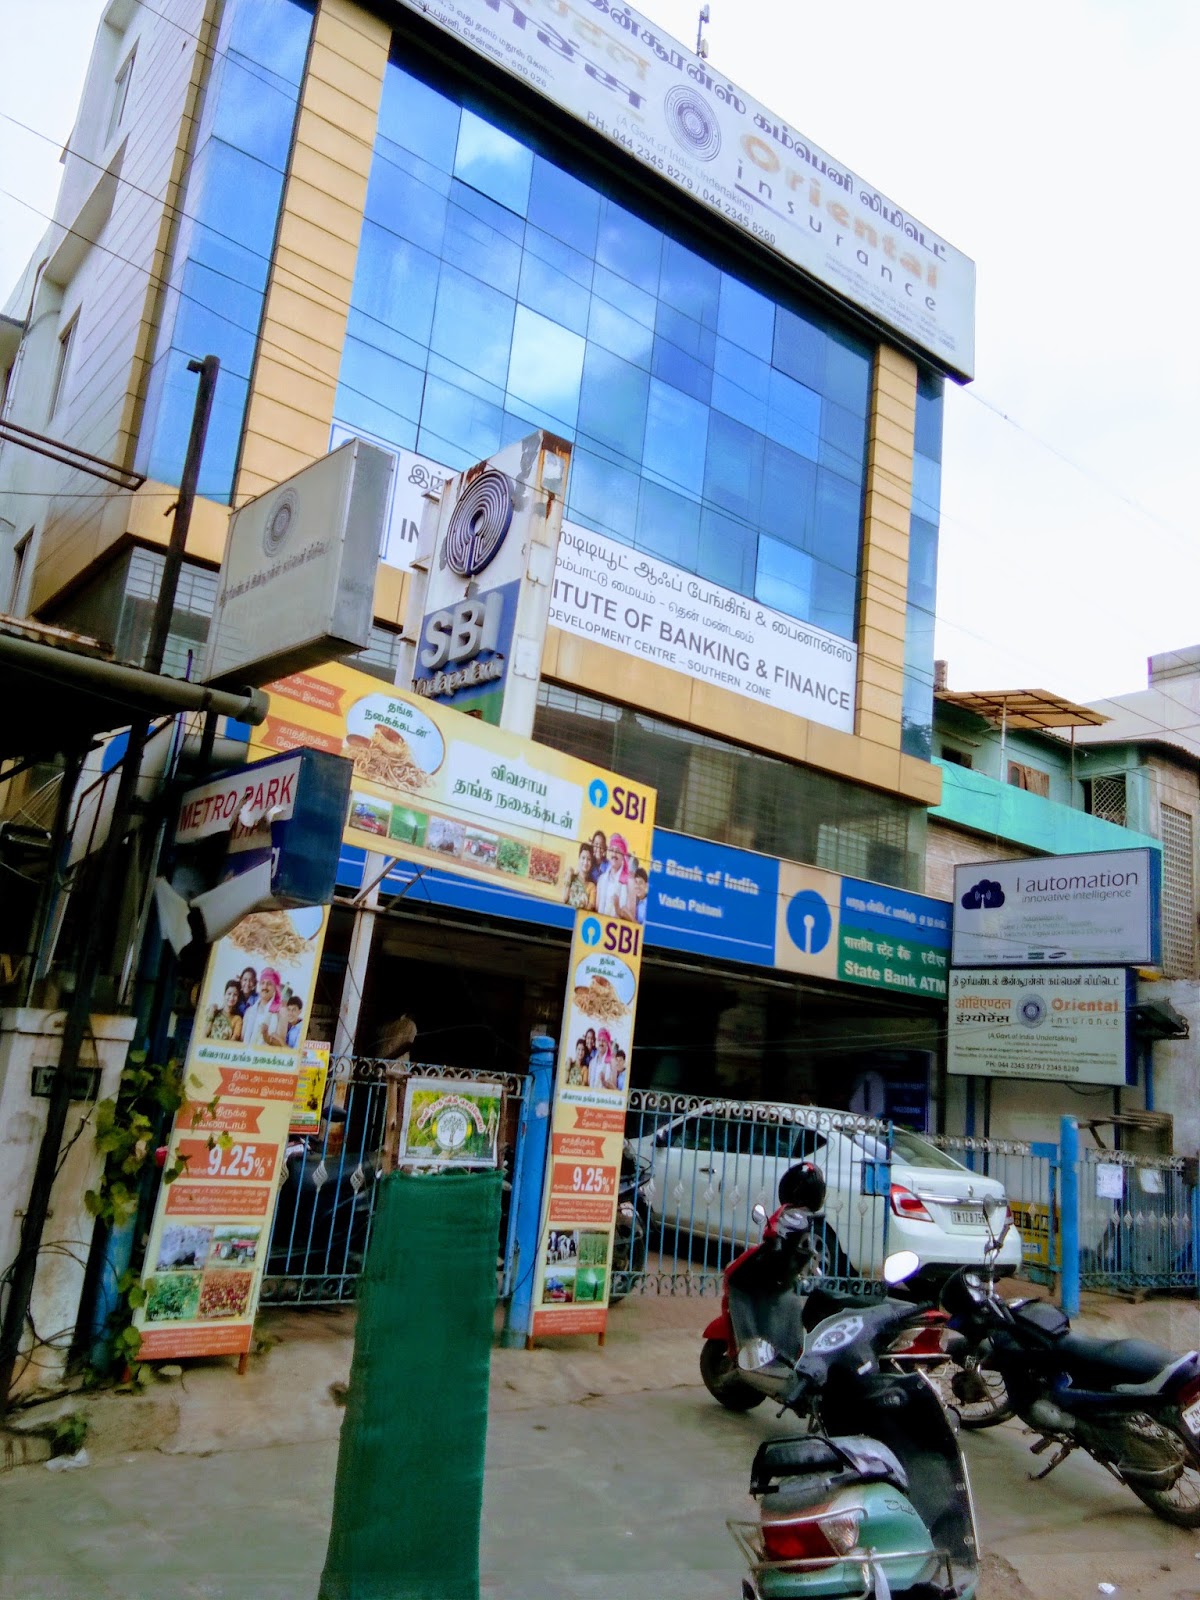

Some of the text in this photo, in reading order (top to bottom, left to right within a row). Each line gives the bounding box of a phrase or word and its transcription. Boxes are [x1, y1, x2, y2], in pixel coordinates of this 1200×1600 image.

[586, 110, 609, 135] PH:
[612, 127, 634, 151] 044
[636, 144, 665, 170] 2345
[666, 162, 694, 190] 8279
[702, 188, 722, 210] 044
[724, 202, 750, 229] 2345
[751, 218, 777, 246] 8280
[753, 112, 854, 195] கம்பெனி
[859, 190, 947, 263] லிமிடெட்
[740, 132, 938, 290] Oriental
[735, 158, 936, 312] insurance
[421, 592, 503, 672] SBI
[754, 610, 768, 627] &
[548, 606, 631, 649] DEVELOPMENT
[634, 639, 676, 664] CENTRE
[687, 660, 741, 688] SOUTHERN
[745, 681, 772, 700] ZONE
[624, 607, 654, 634] OF
[660, 620, 750, 671] BANKING
[756, 659, 769, 680] &
[774, 666, 850, 711] FINANCE
[387, 701, 414, 719] தங்க
[491, 764, 548, 797] விவசாய
[179, 790, 238, 832] METRO
[452, 778, 574, 830] தங்க நகைக்கடன்
[610, 786, 647, 824] SBI
[665, 858, 703, 882] Bank
[705, 870, 721, 886] of
[724, 872, 759, 896] India
[1022, 888, 1131, 903] innovative intelligence
[1025, 869, 1139, 893] automation
[658, 892, 686, 911] Vada
[604, 922, 640, 956] SBI
[844, 959, 947, 994] State Bank ATM
[1051, 998, 1119, 1012] Oriental
